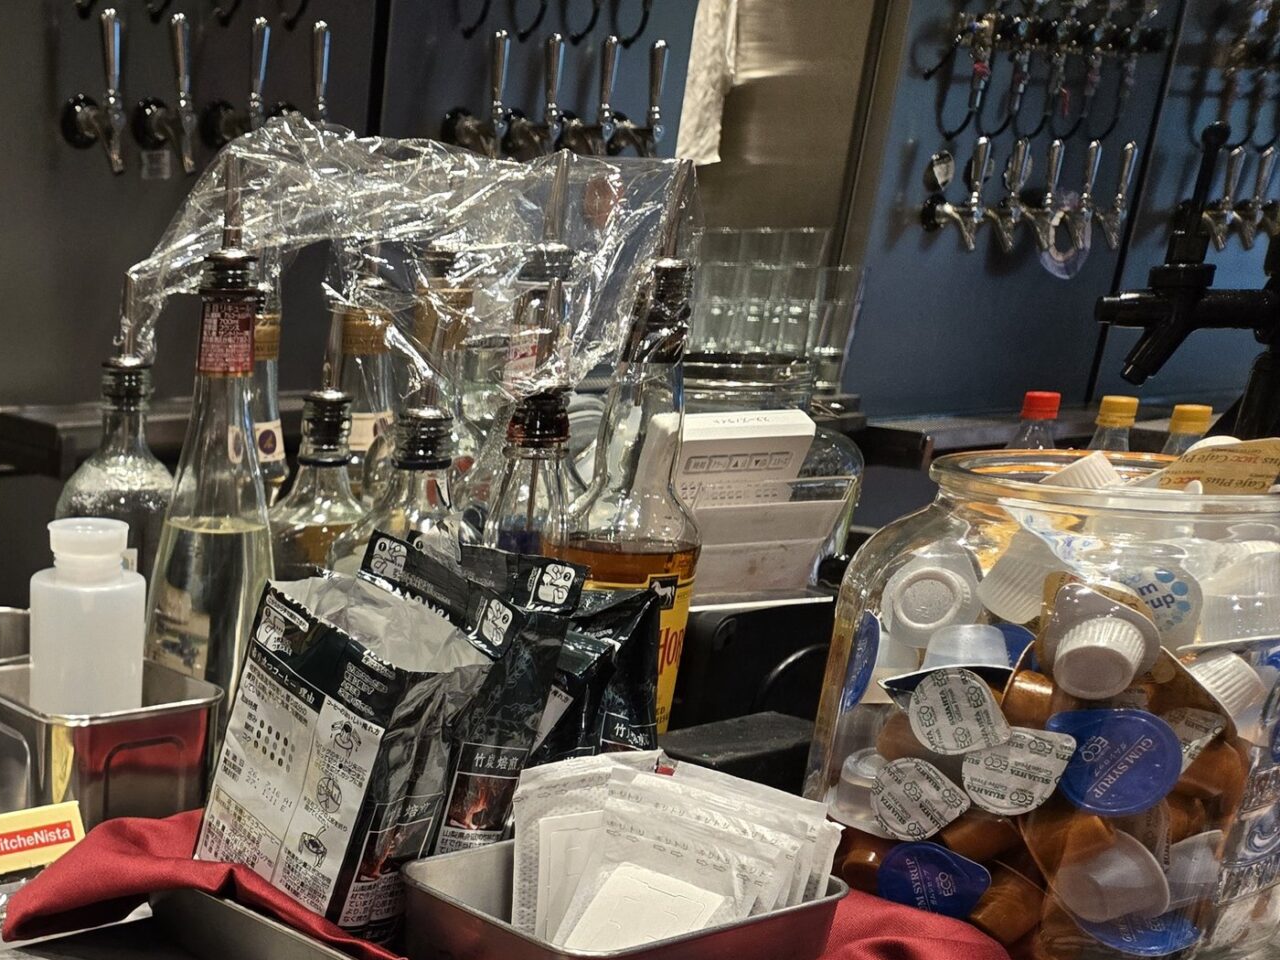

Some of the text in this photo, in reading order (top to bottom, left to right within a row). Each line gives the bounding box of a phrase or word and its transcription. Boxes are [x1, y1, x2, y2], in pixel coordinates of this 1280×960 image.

[1206, 477, 1232, 487] Plus
[1081, 736, 1109, 762] ECO
[1093, 738, 1153, 799] GUM SYRUP
[905, 858, 922, 894] SYRUP
[938, 871, 954, 897] ECO
